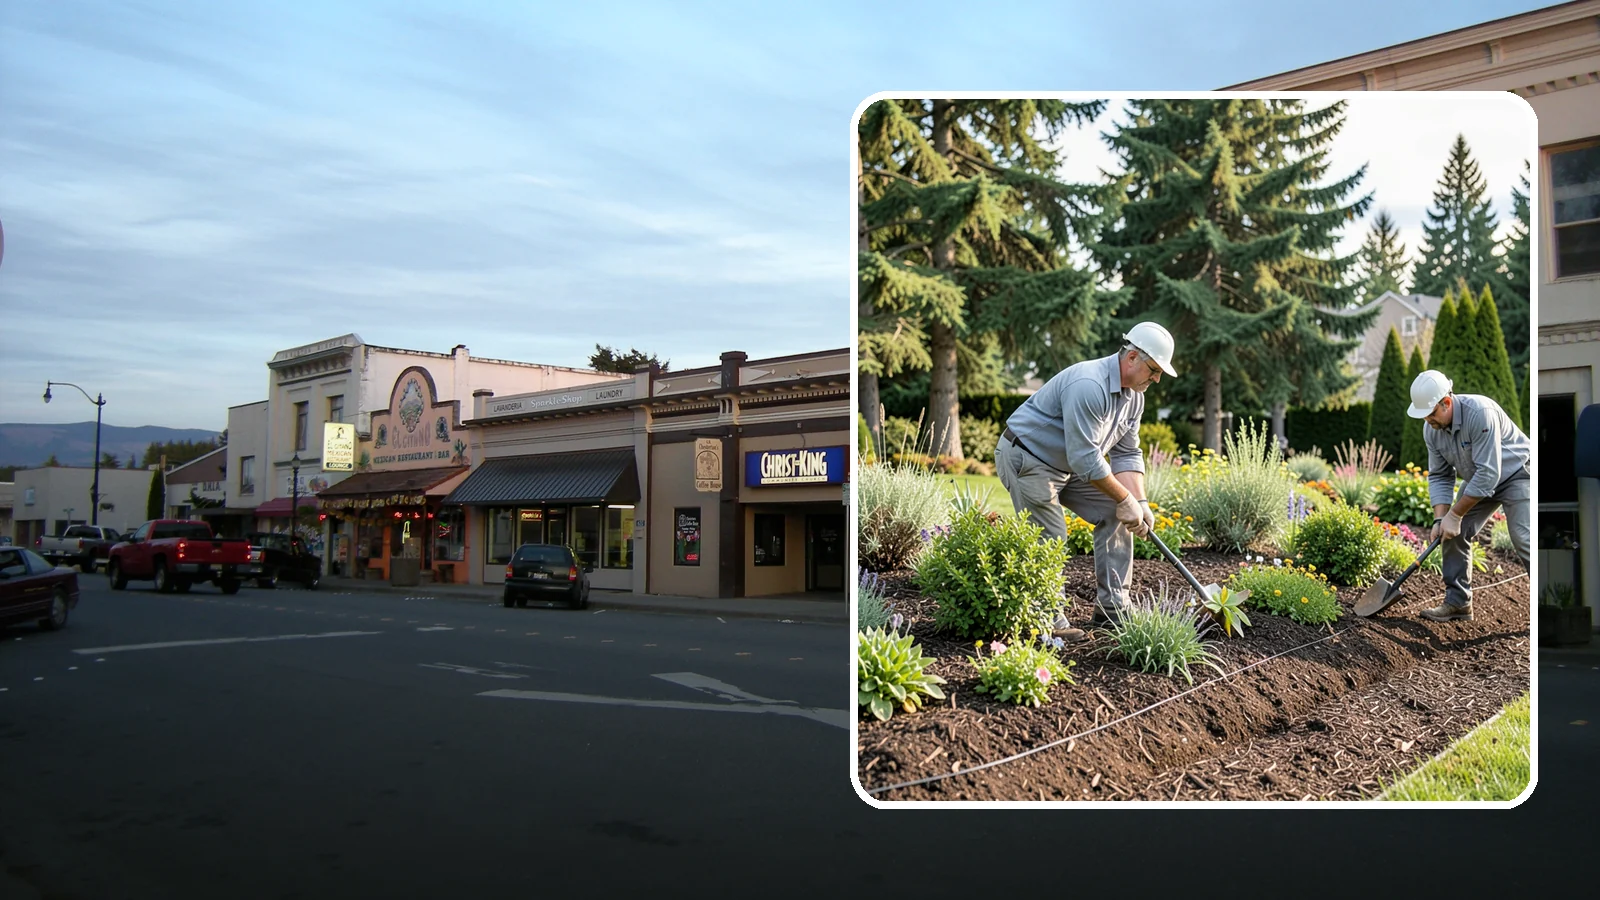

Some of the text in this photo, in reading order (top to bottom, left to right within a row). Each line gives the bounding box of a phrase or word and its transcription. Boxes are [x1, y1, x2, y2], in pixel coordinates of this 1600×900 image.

[595, 389, 624, 400] LAUNDRY
[493, 402, 523, 413] LAVANDERIA
[530, 394, 583, 409] Sparkle Shop
[398, 451, 433, 463] RESTAURANT
[438, 450, 450, 459] BAR
[761, 450, 827, 478] CHRIST KING
